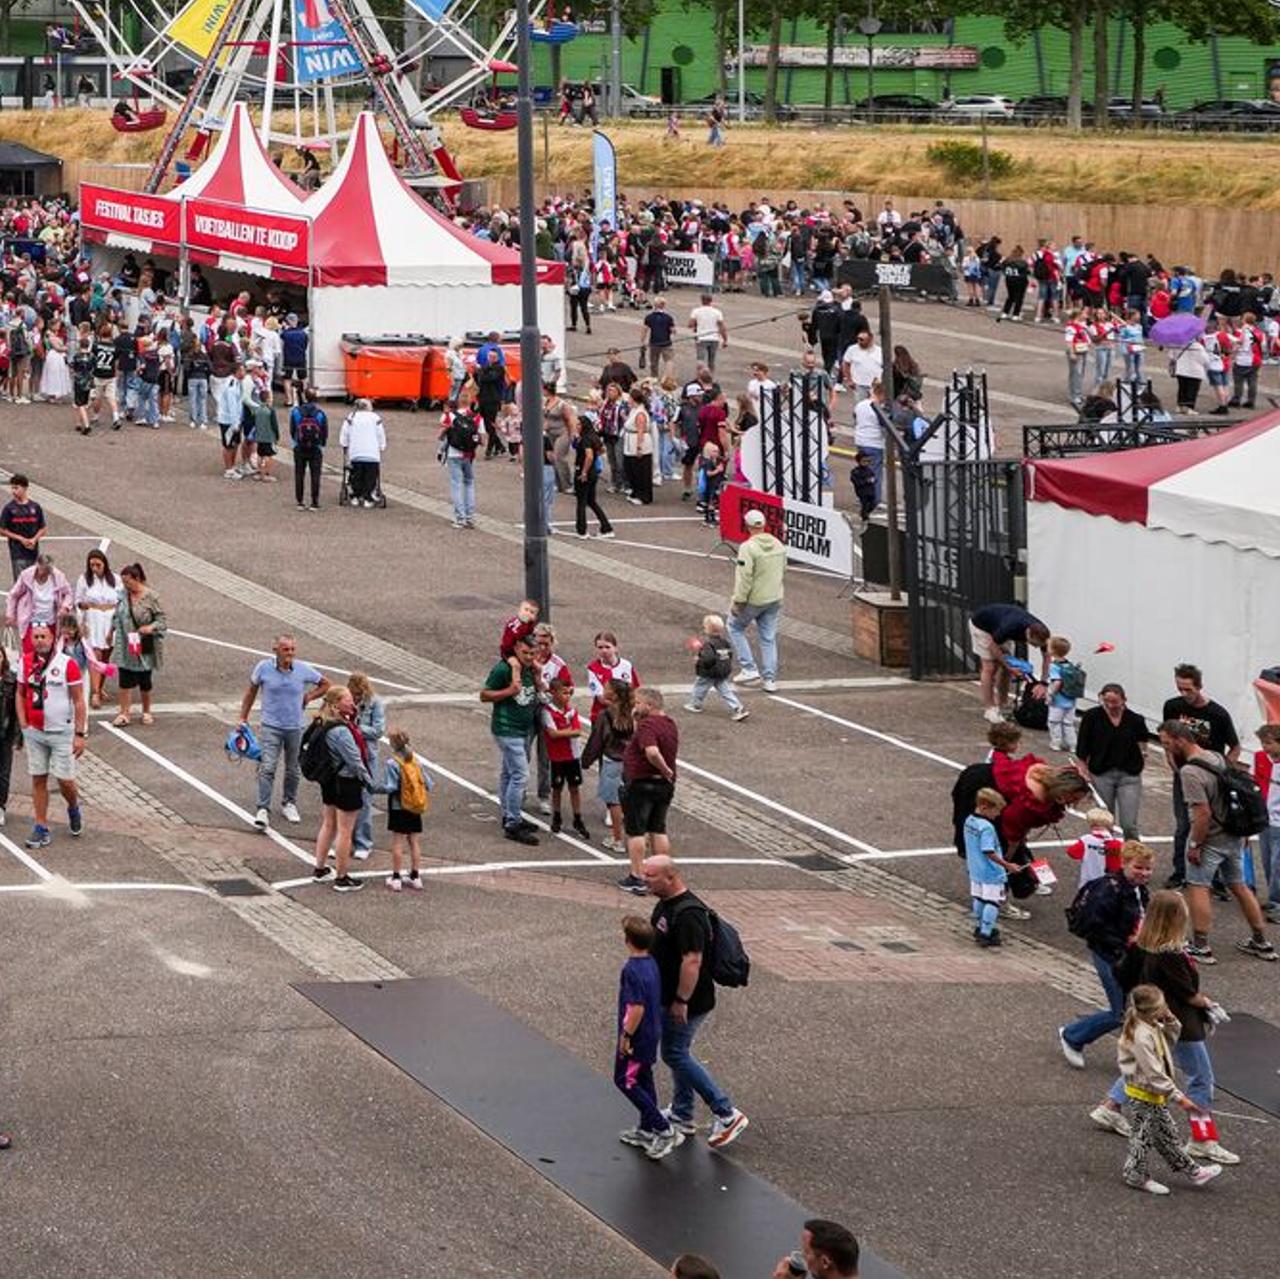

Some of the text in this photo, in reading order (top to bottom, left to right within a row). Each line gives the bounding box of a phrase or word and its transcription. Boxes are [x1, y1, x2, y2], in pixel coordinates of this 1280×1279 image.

[305, 48, 356, 74] WIN
[95, 199, 164, 230] FESTIVAL TASJES
[195, 215, 298, 251] VOETBALLEN TE KOOP
